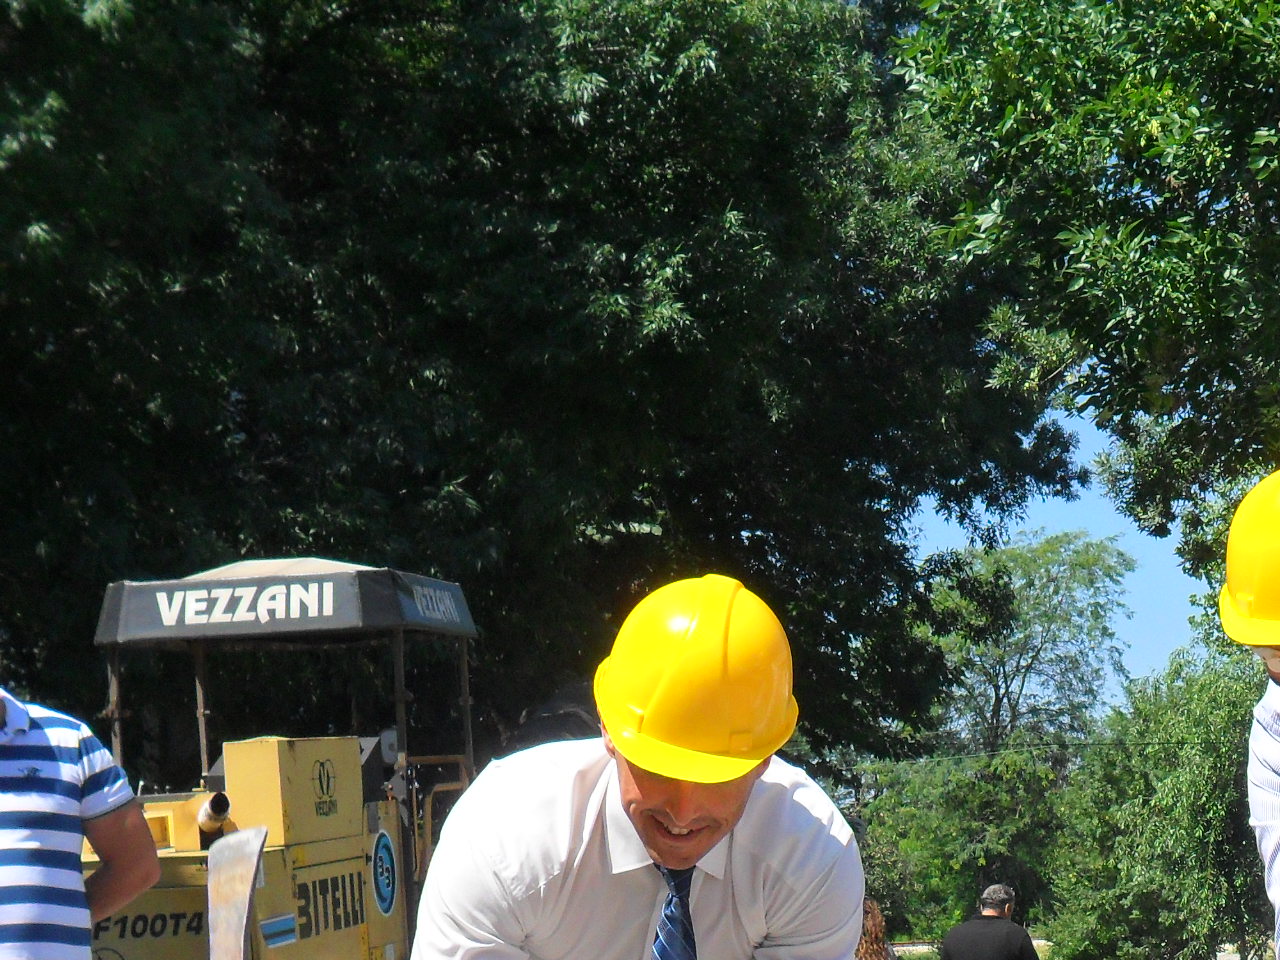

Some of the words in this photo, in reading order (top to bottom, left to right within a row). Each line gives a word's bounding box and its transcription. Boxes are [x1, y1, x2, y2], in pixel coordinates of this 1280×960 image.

[156, 582, 334, 626] VEZZANI
[412, 585, 461, 623] VEZZANI
[297, 871, 365, 940] BITELLI
